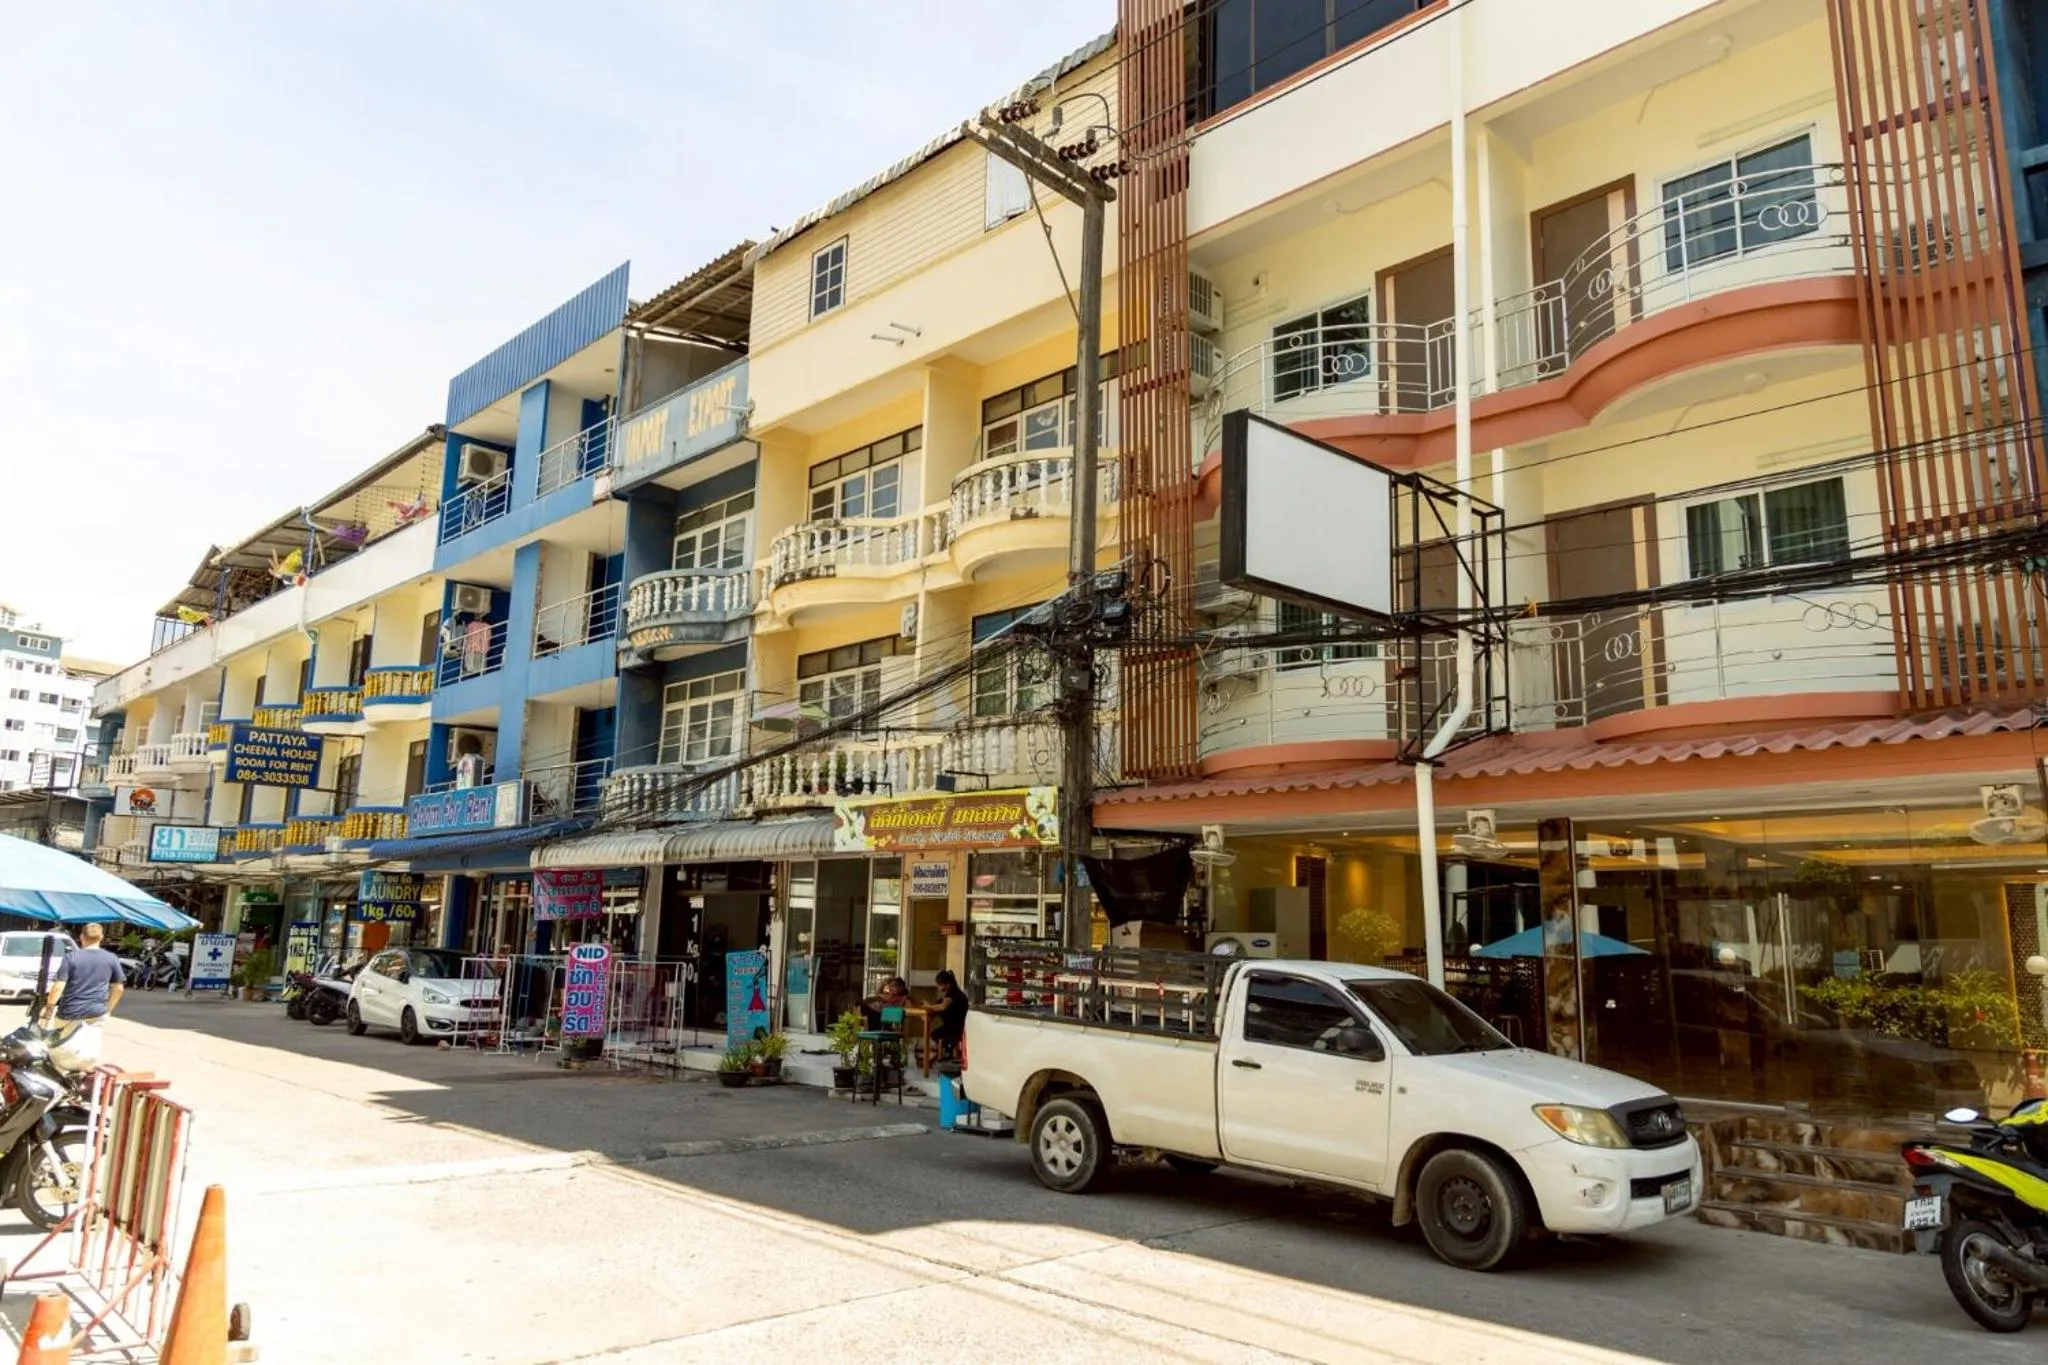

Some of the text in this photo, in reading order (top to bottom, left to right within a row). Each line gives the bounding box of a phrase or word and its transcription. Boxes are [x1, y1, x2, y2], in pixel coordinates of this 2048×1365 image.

[627, 375, 737, 466] IMPORT EXPORT
[249, 731, 307, 747] PATTAYA
[234, 743, 318, 761] CHEENA HOUSE
[235, 756, 314, 772] ROOM FOR RENT
[409, 790, 493, 831] Room For Rent
[156, 828, 186, 849] ยา
[152, 848, 217, 862] Pharmacy
[362, 883, 420, 900] LAUNDRY
[535, 885, 600, 899] Laundry
[692, 914, 698, 932] 1
[577, 948, 604, 959] NID
[570, 963, 594, 985] ซัก
[567, 991, 592, 1006] อบ
[592, 962, 605, 1032] LAUNDRY
[564, 1010, 589, 1032] รีด
